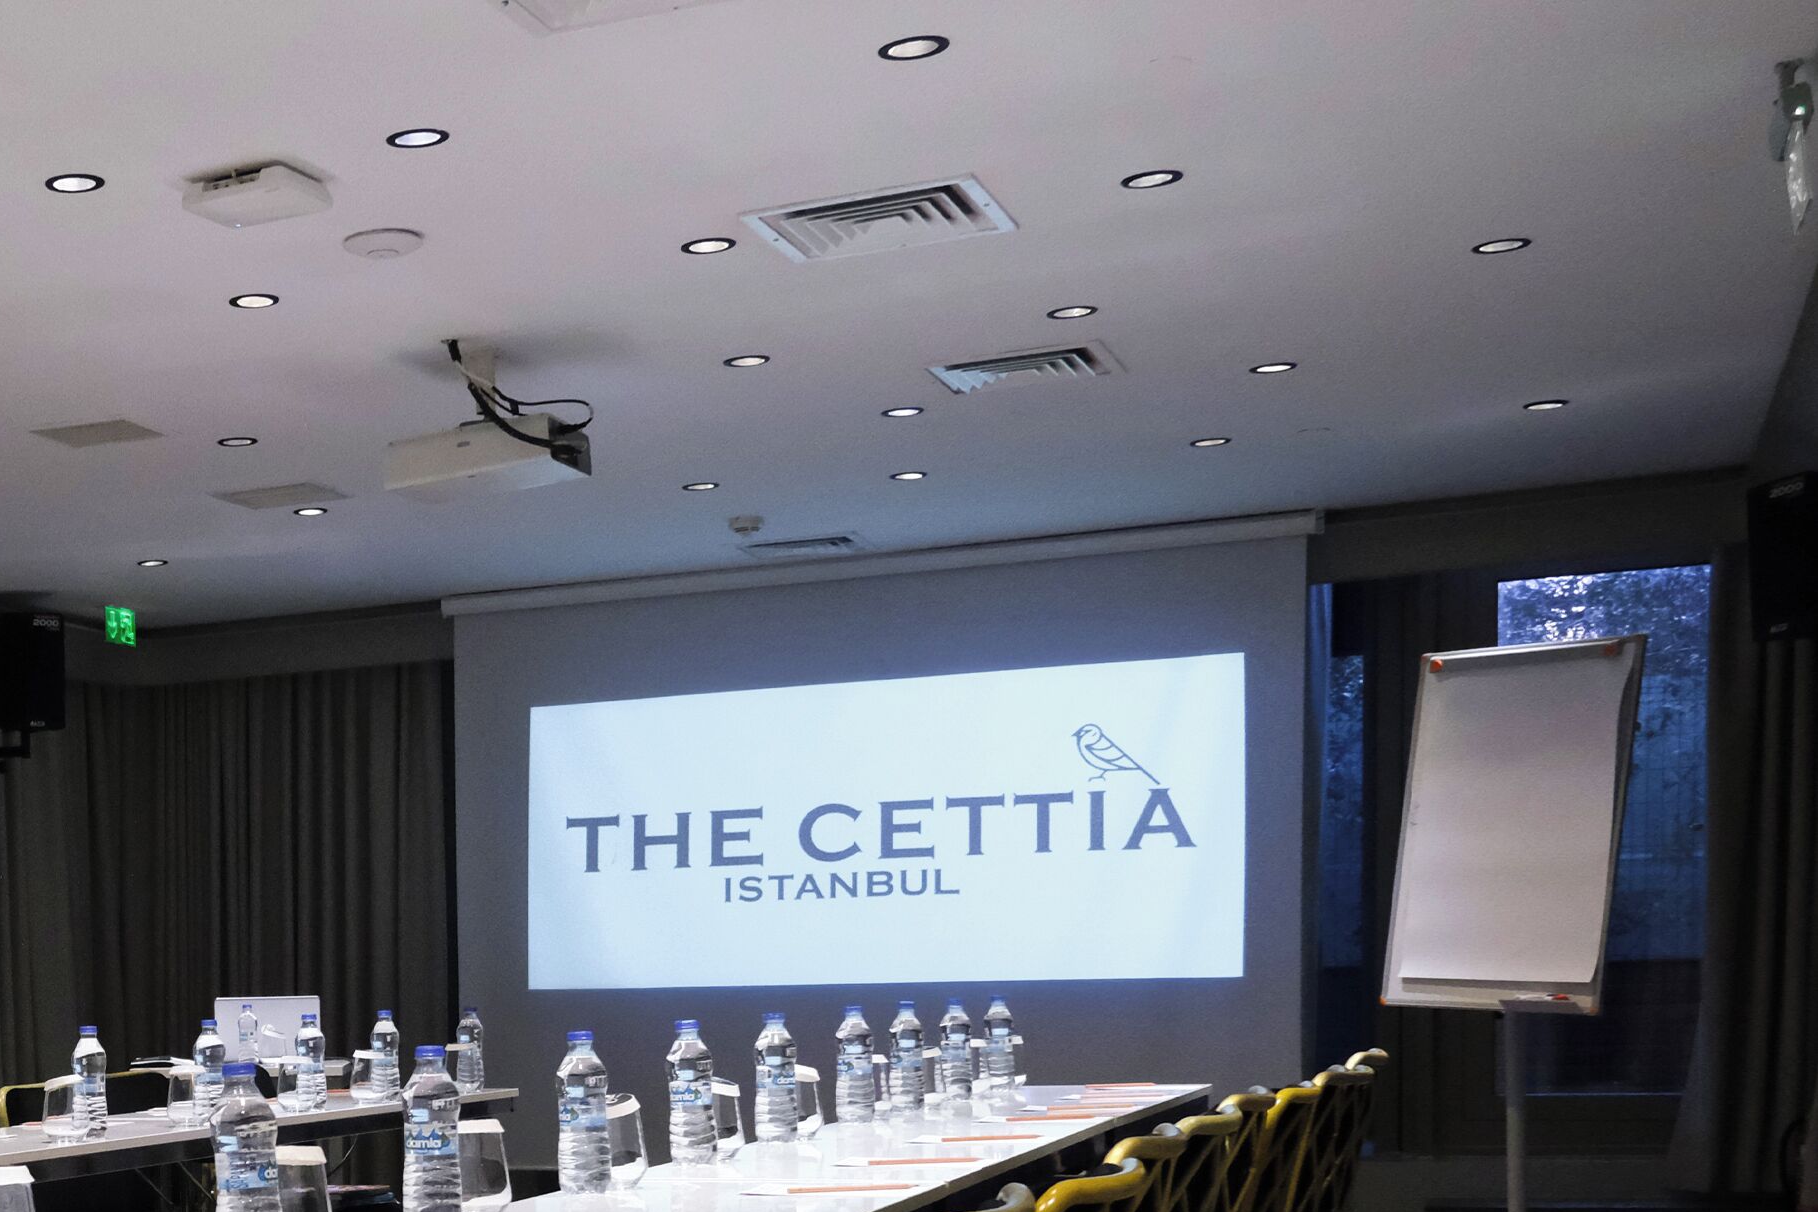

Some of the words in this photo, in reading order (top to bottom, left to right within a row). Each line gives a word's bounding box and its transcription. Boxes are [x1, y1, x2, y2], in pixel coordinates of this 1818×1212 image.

[566, 806, 764, 873] THE
[798, 786, 1197, 862] CETTIA
[724, 868, 961, 904] ISTANBUL
